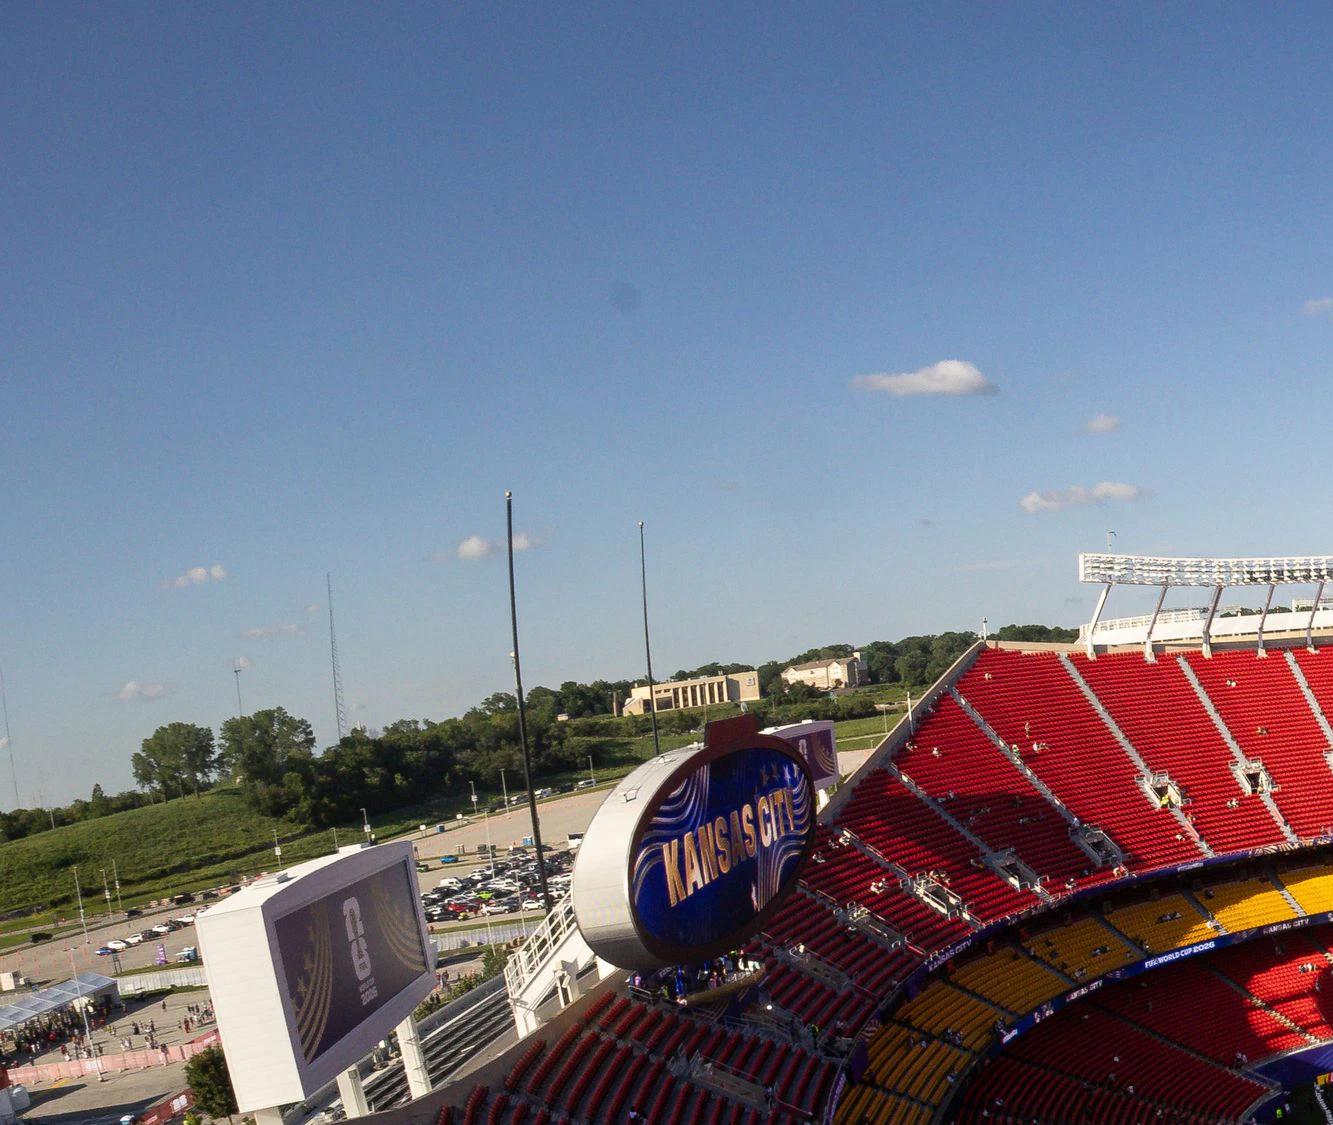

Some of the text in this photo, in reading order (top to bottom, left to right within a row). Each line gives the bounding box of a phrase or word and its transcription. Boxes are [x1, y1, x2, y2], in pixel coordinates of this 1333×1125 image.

[663, 787, 795, 908] KANSAS CITY
[1292, 918, 1309, 928] CITY
[929, 939, 972, 972] KANSAS CITY
[1145, 941, 1215, 968] FIFA WORLD CUP 2026
